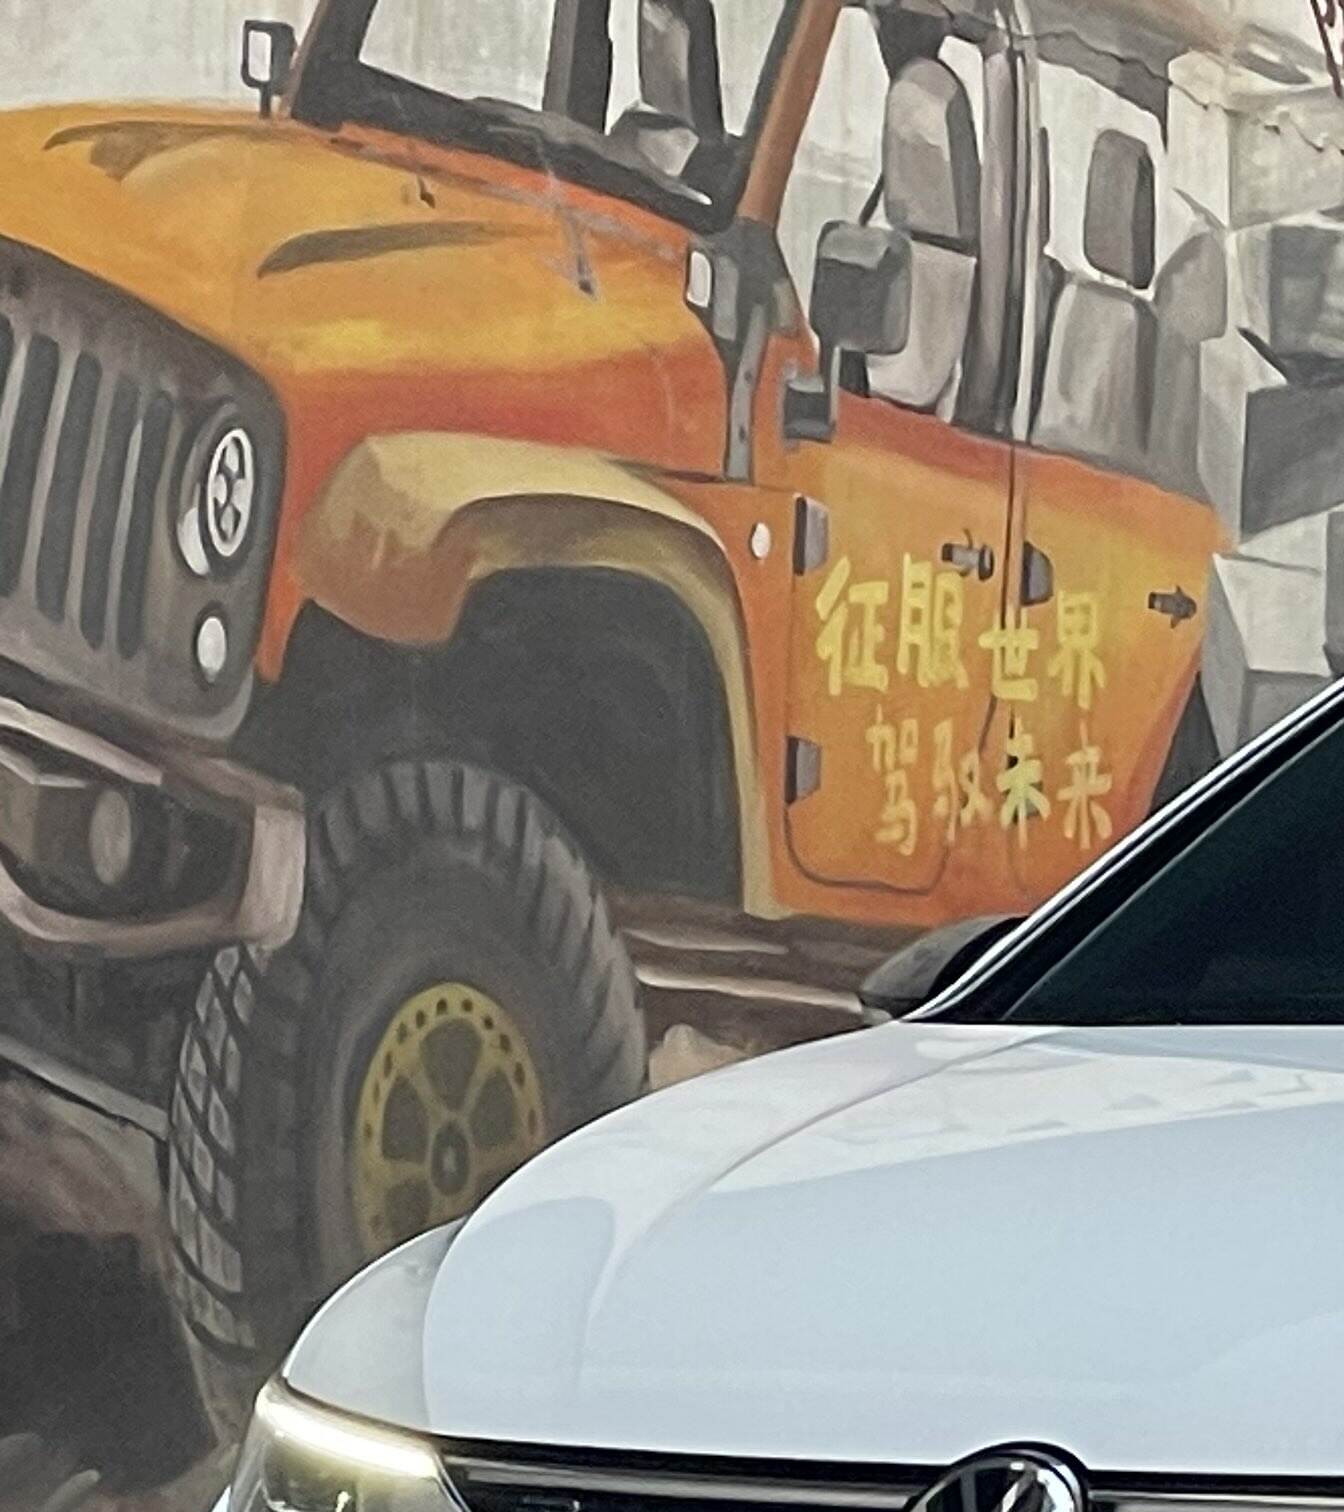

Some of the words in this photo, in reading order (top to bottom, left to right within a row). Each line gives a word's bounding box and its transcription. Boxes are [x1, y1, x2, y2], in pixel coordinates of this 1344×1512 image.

[815, 553, 1105, 709] 征服世界
[866, 704, 1113, 856] 驾驭未来
